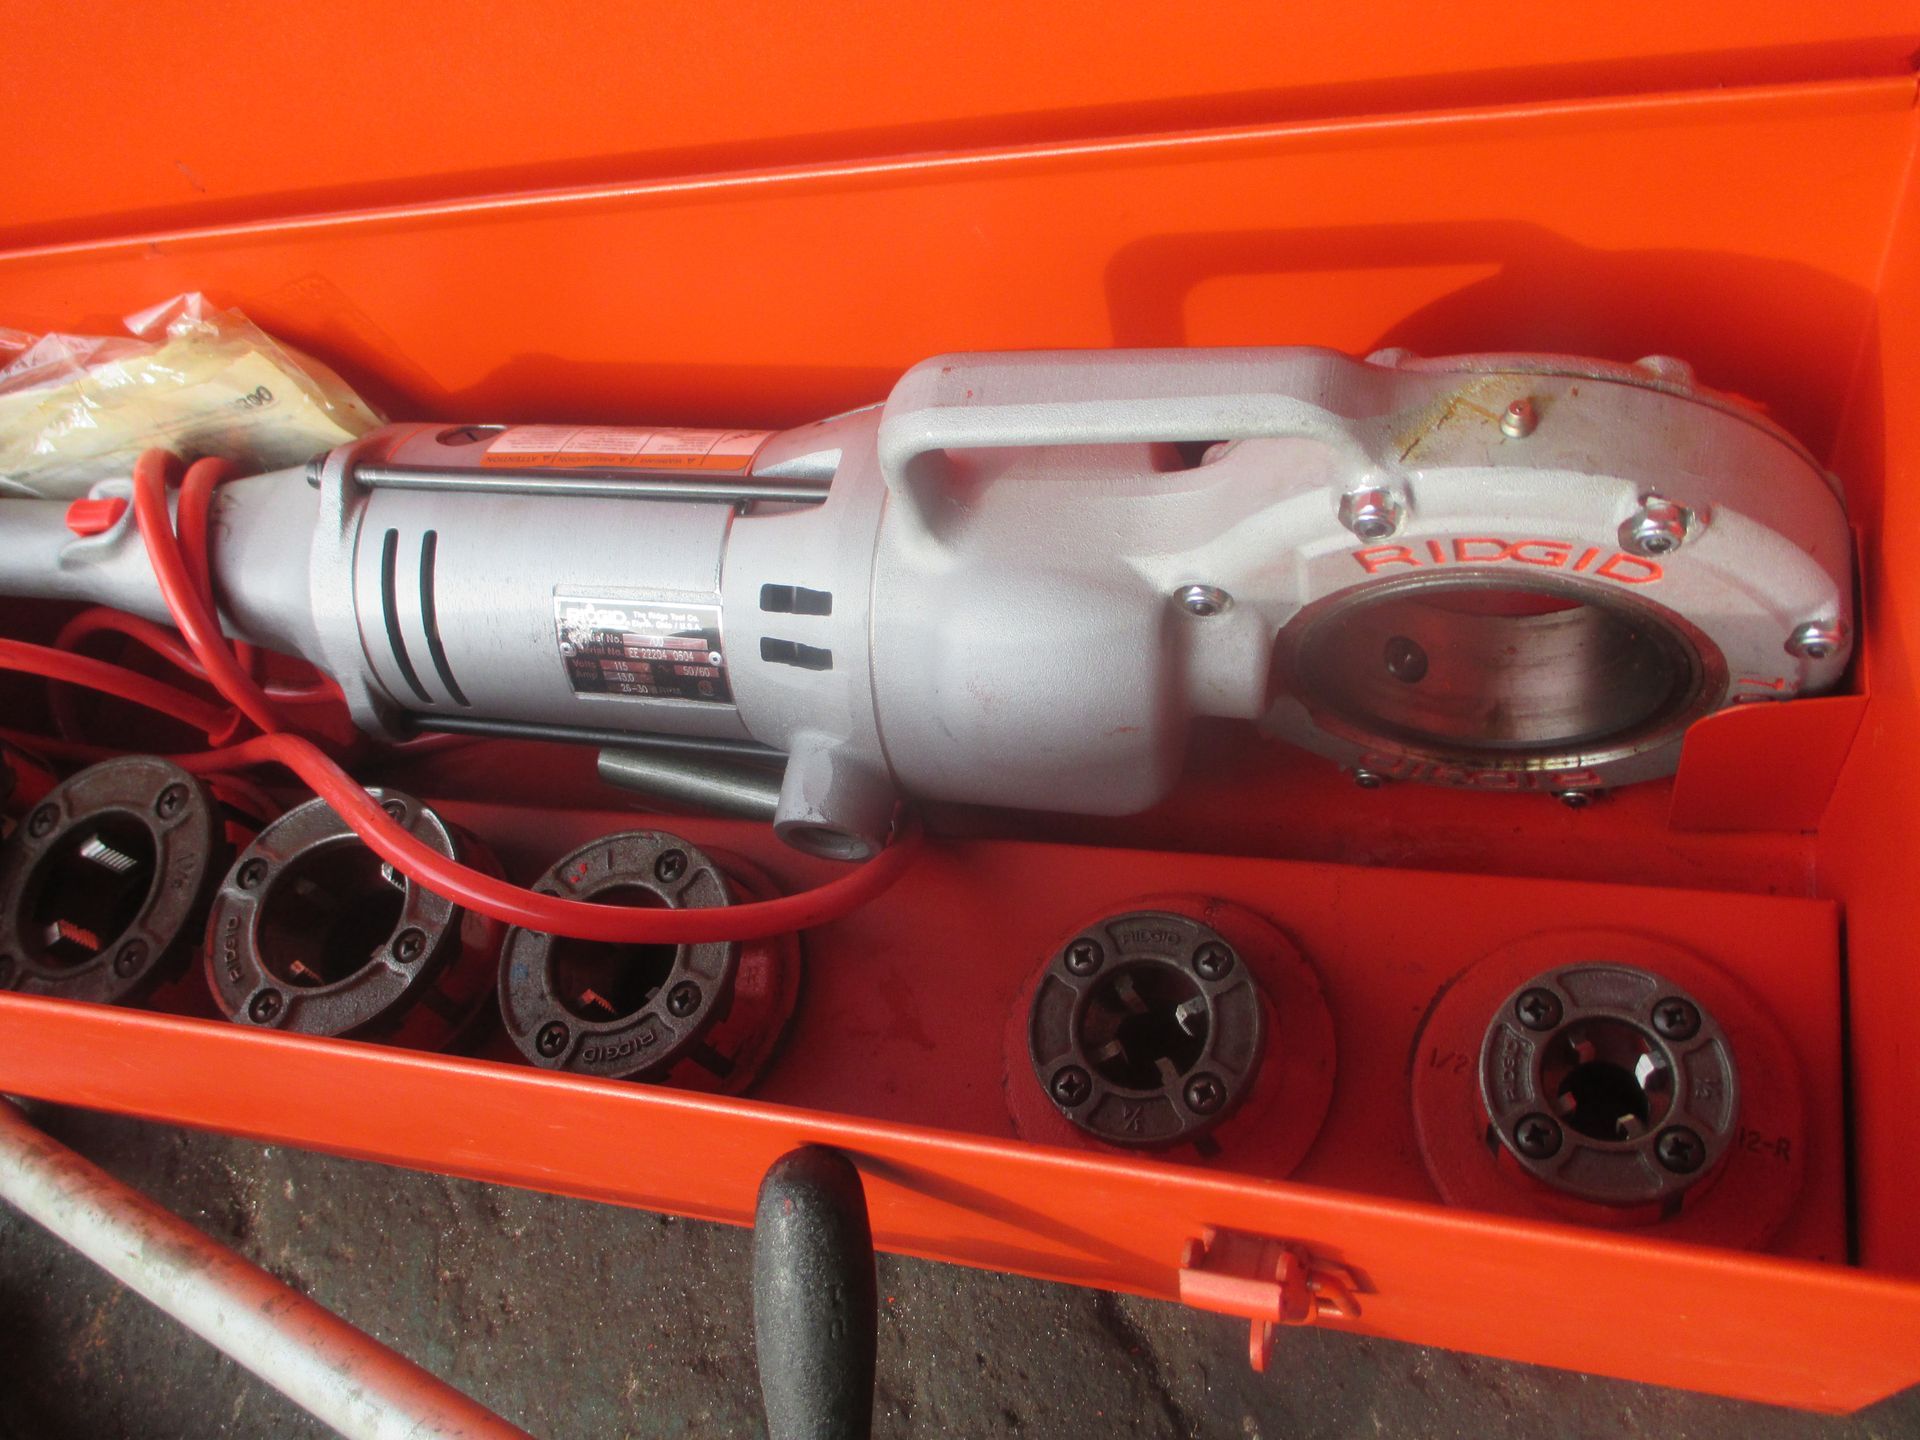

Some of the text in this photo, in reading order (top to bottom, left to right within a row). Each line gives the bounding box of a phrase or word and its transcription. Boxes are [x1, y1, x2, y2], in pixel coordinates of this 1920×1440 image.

[1352, 537, 1664, 585] RIDGID
[605, 633, 623, 644] No.
[629, 647, 640, 659] EE
[641, 648, 668, 660] 22204
[614, 661, 629, 671] 115
[682, 665, 711, 678] 50/60
[620, 683, 649, 694] 26-30
[582, 1030, 656, 1062] RIDGID
[1429, 1047, 1469, 1075] 1/2
[1737, 1126, 1792, 1162] 12-R
